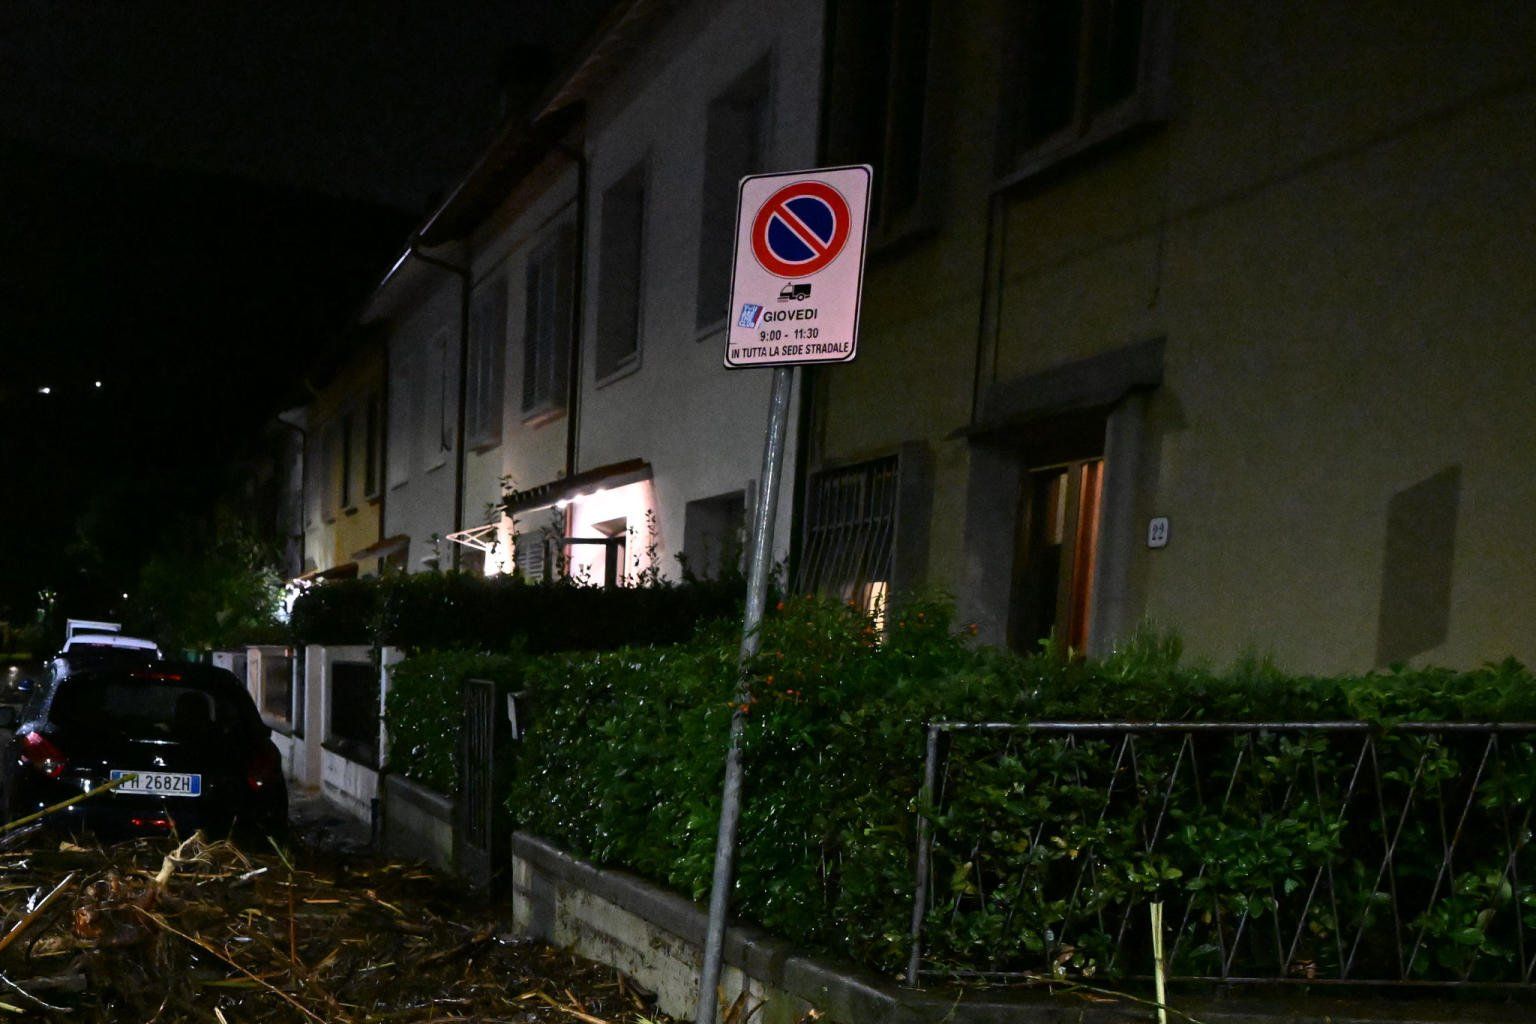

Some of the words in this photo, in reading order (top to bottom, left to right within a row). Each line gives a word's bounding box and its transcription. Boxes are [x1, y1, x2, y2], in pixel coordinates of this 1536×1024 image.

[763, 309, 818, 322] GIOVEDI
[760, 330, 781, 342] 9:00
[794, 327, 819, 339] 11:30
[731, 348, 740, 359] IN
[742, 346, 767, 358] TUTTA
[769, 345, 780, 357] LA
[781, 344, 803, 356] SEDE
[805, 342, 849, 355] STRADALE
[145, 775, 190, 791] 268ZH
